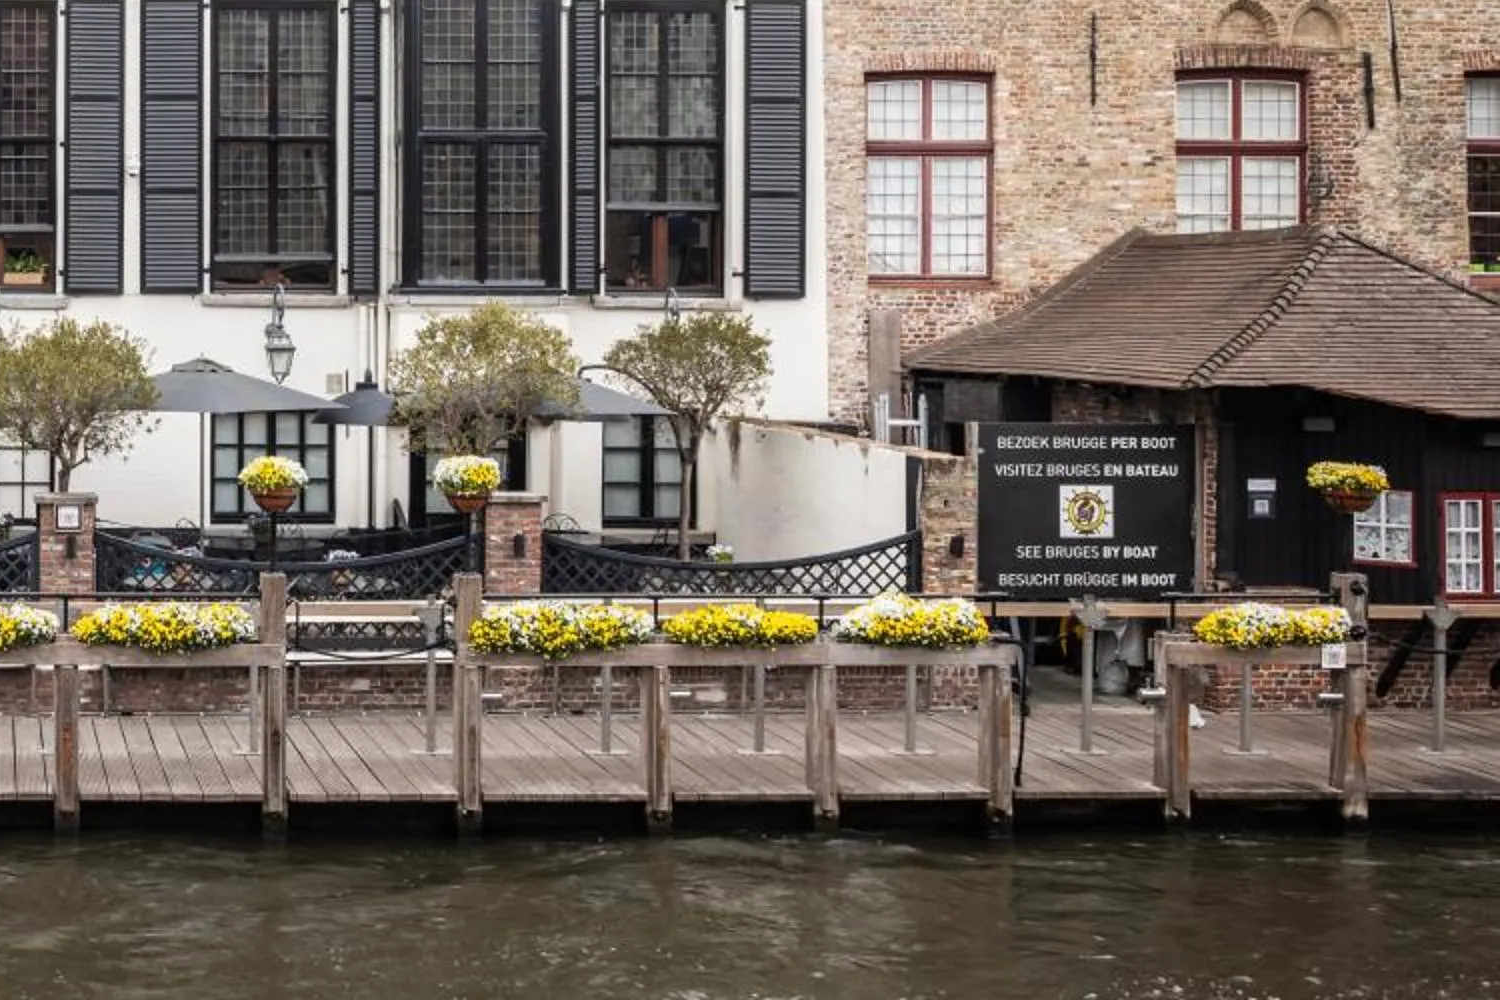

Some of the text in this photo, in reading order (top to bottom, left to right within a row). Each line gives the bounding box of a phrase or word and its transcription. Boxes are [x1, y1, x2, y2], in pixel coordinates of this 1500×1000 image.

[997, 436, 1176, 449] BEZOEK BRUGGE PER BOOT
[994, 463, 1179, 477] VISITEZ BRUGES EN BATEAU
[1016, 545, 1158, 559] SEE BRUGES BY BOAT
[998, 571, 1176, 587] BESUCHT BRÜGGE IM BOOT
